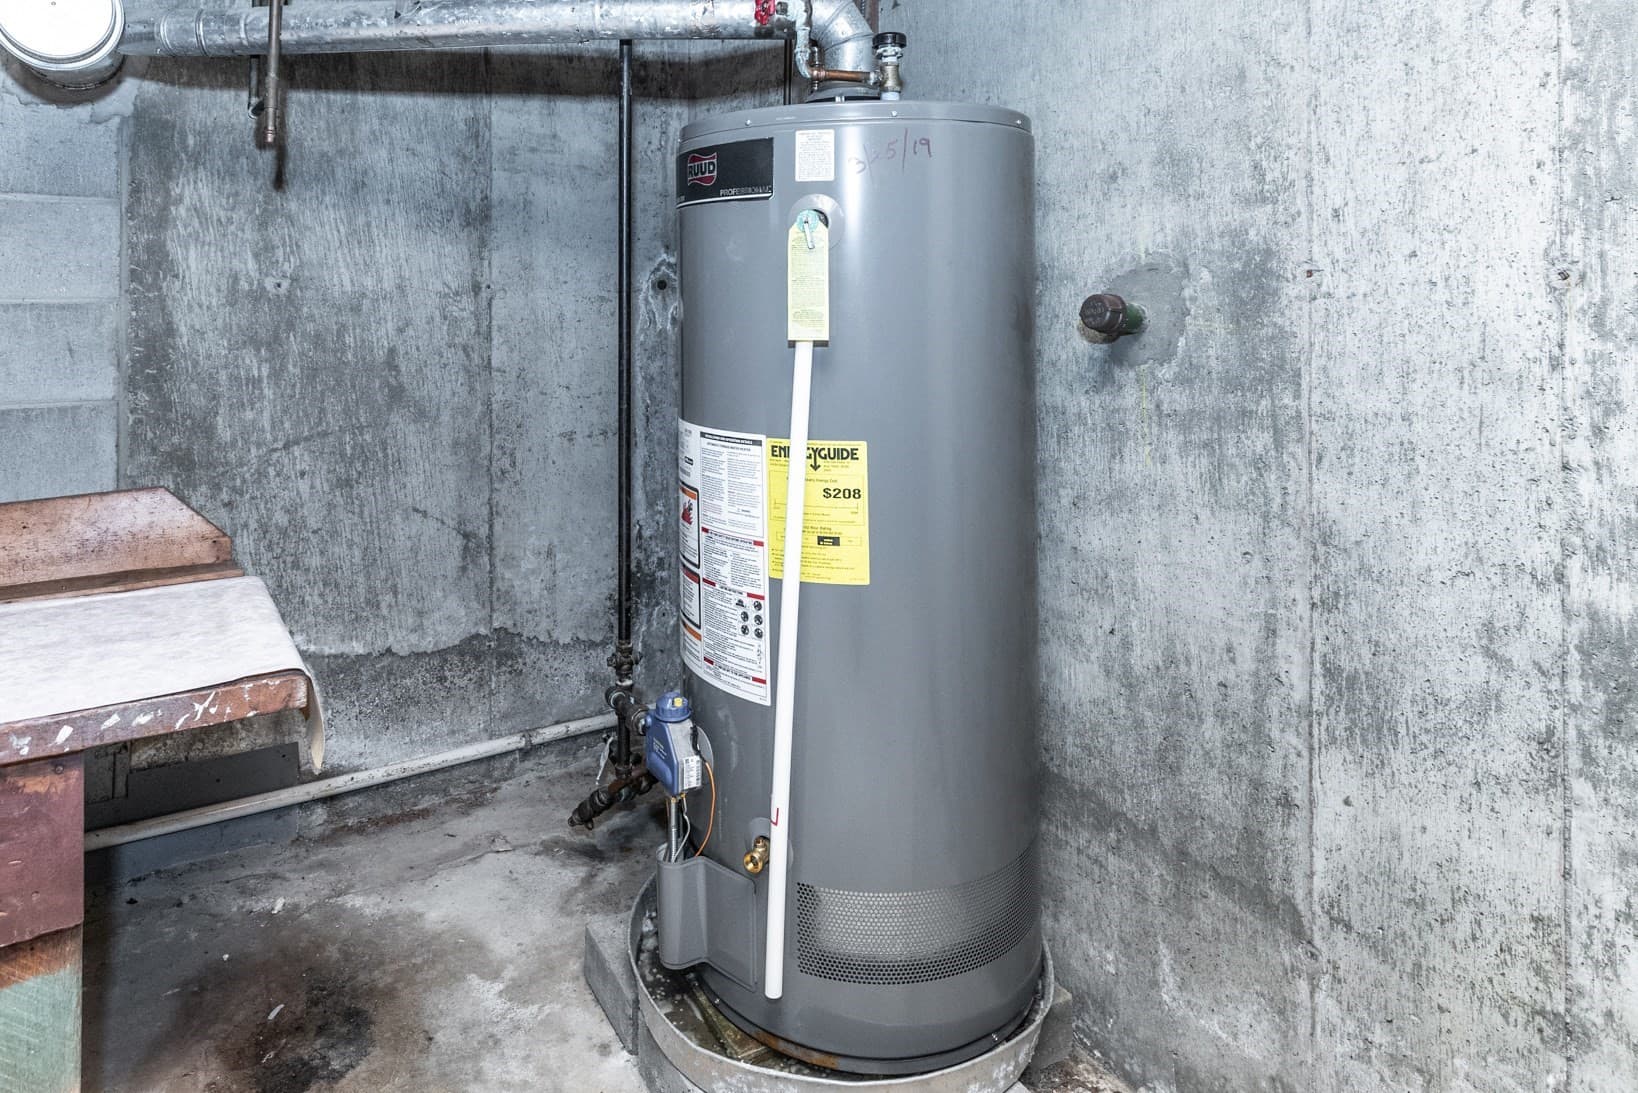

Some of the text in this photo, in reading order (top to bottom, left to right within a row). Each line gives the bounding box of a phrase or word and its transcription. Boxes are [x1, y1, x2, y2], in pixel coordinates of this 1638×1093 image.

[688, 161, 716, 178] RUUD
[771, 445, 859, 461] ENGYGUIDE
[822, 487, 862, 500] $208
